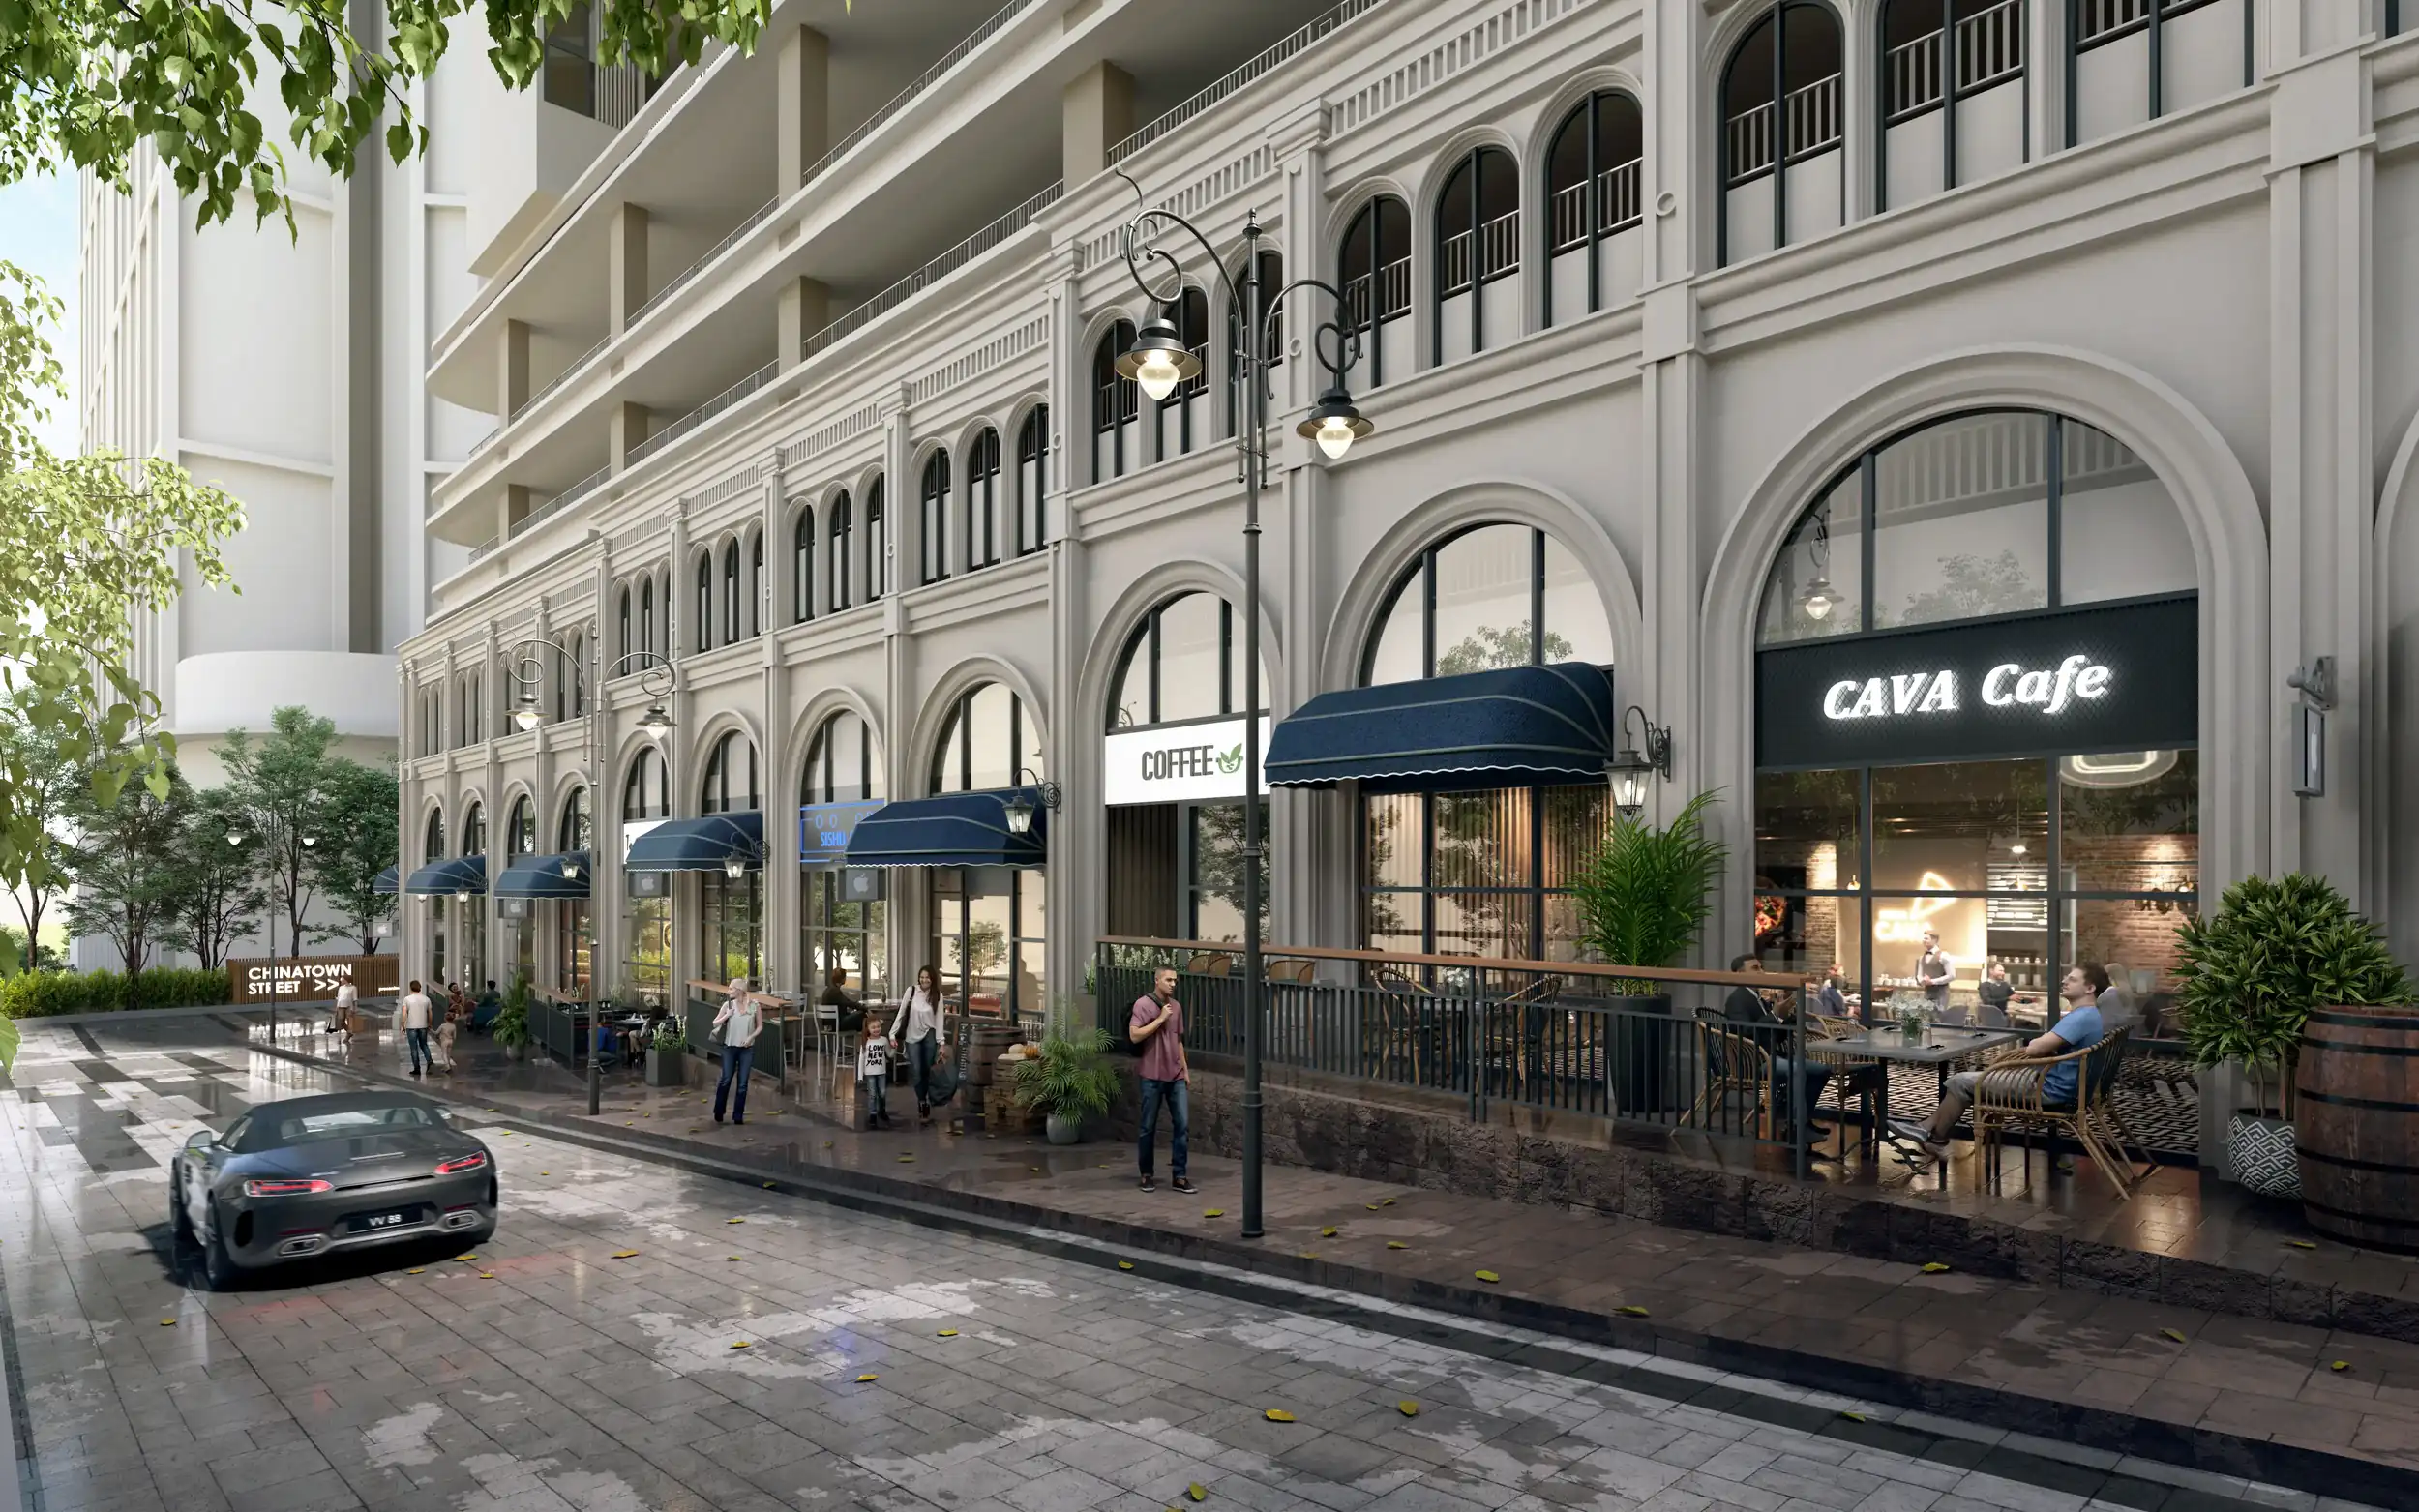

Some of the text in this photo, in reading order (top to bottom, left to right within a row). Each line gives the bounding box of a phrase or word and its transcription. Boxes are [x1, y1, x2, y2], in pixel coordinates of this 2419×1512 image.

[1823, 654, 2109, 720] CAVA Cafe
[1142, 745, 1214, 780] COFFEE
[248, 964, 352, 980] CHINATOWN
